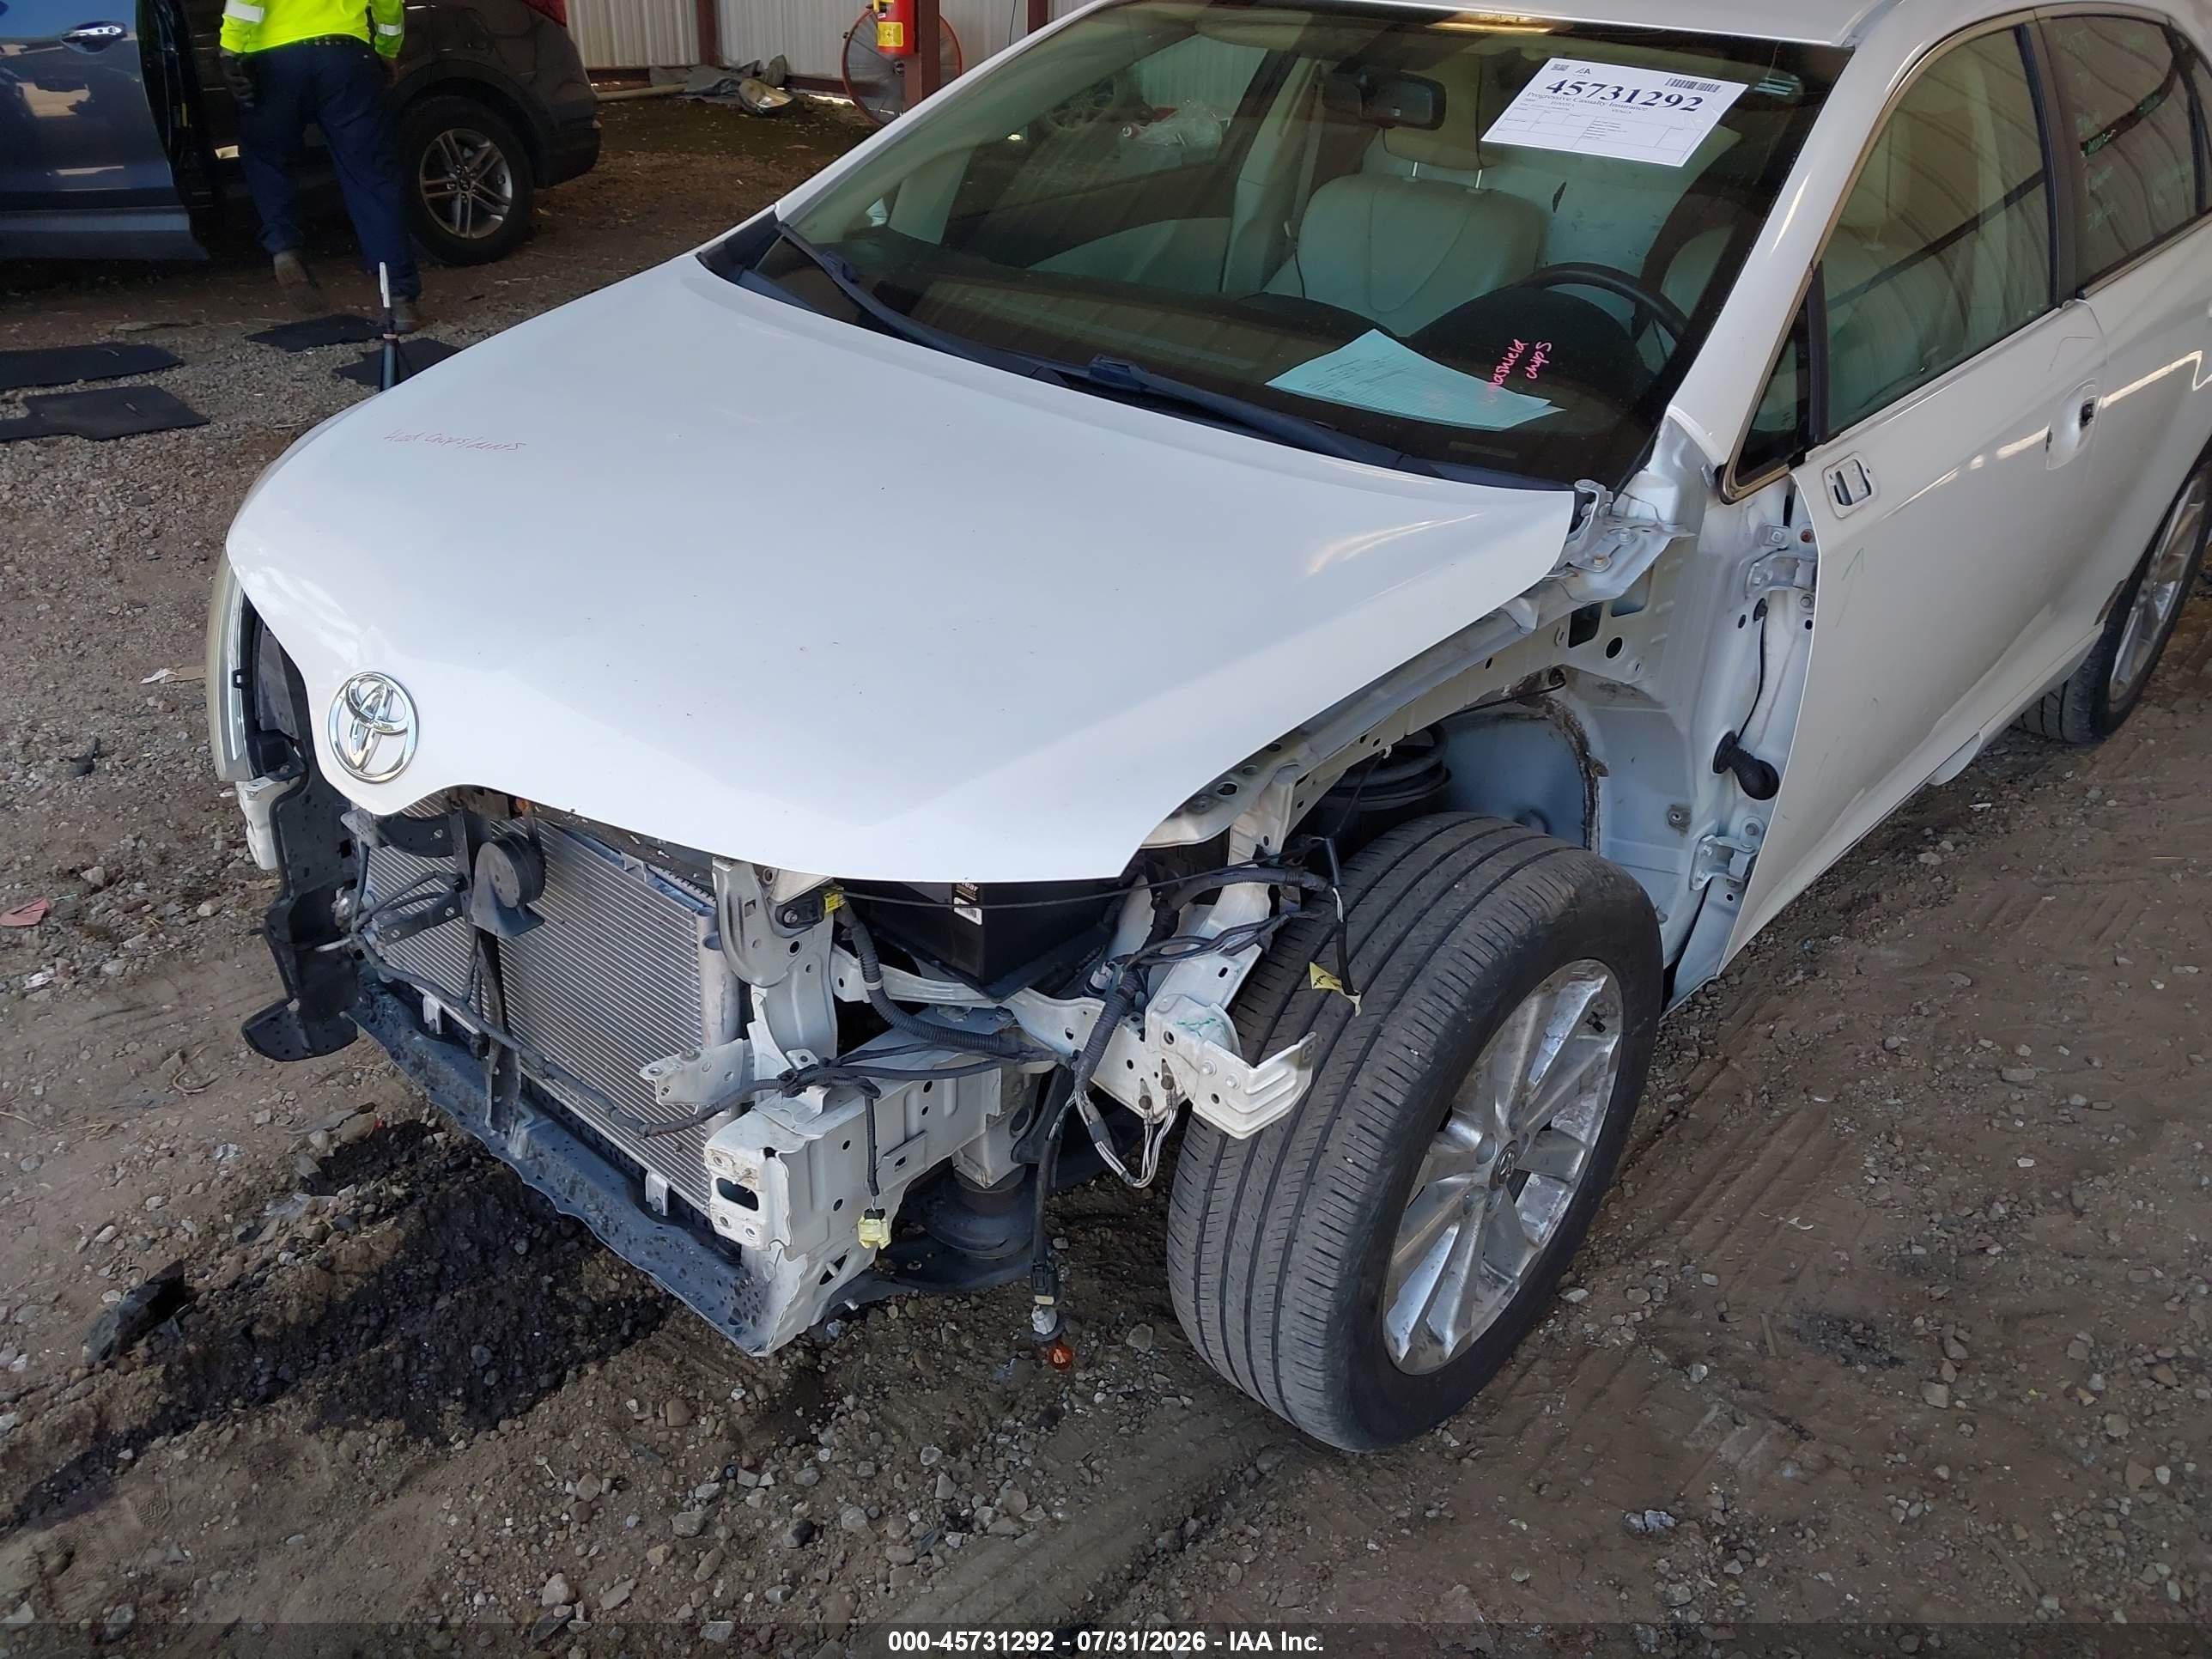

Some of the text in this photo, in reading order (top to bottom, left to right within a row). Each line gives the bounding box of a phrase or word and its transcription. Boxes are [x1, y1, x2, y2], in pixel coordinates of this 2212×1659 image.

[1527, 91, 1573, 101] Progressive
[1573, 96, 1606, 107] Casualty
[1608, 101, 1649, 112] Insurance
[1545, 79, 1704, 112] 45731292
